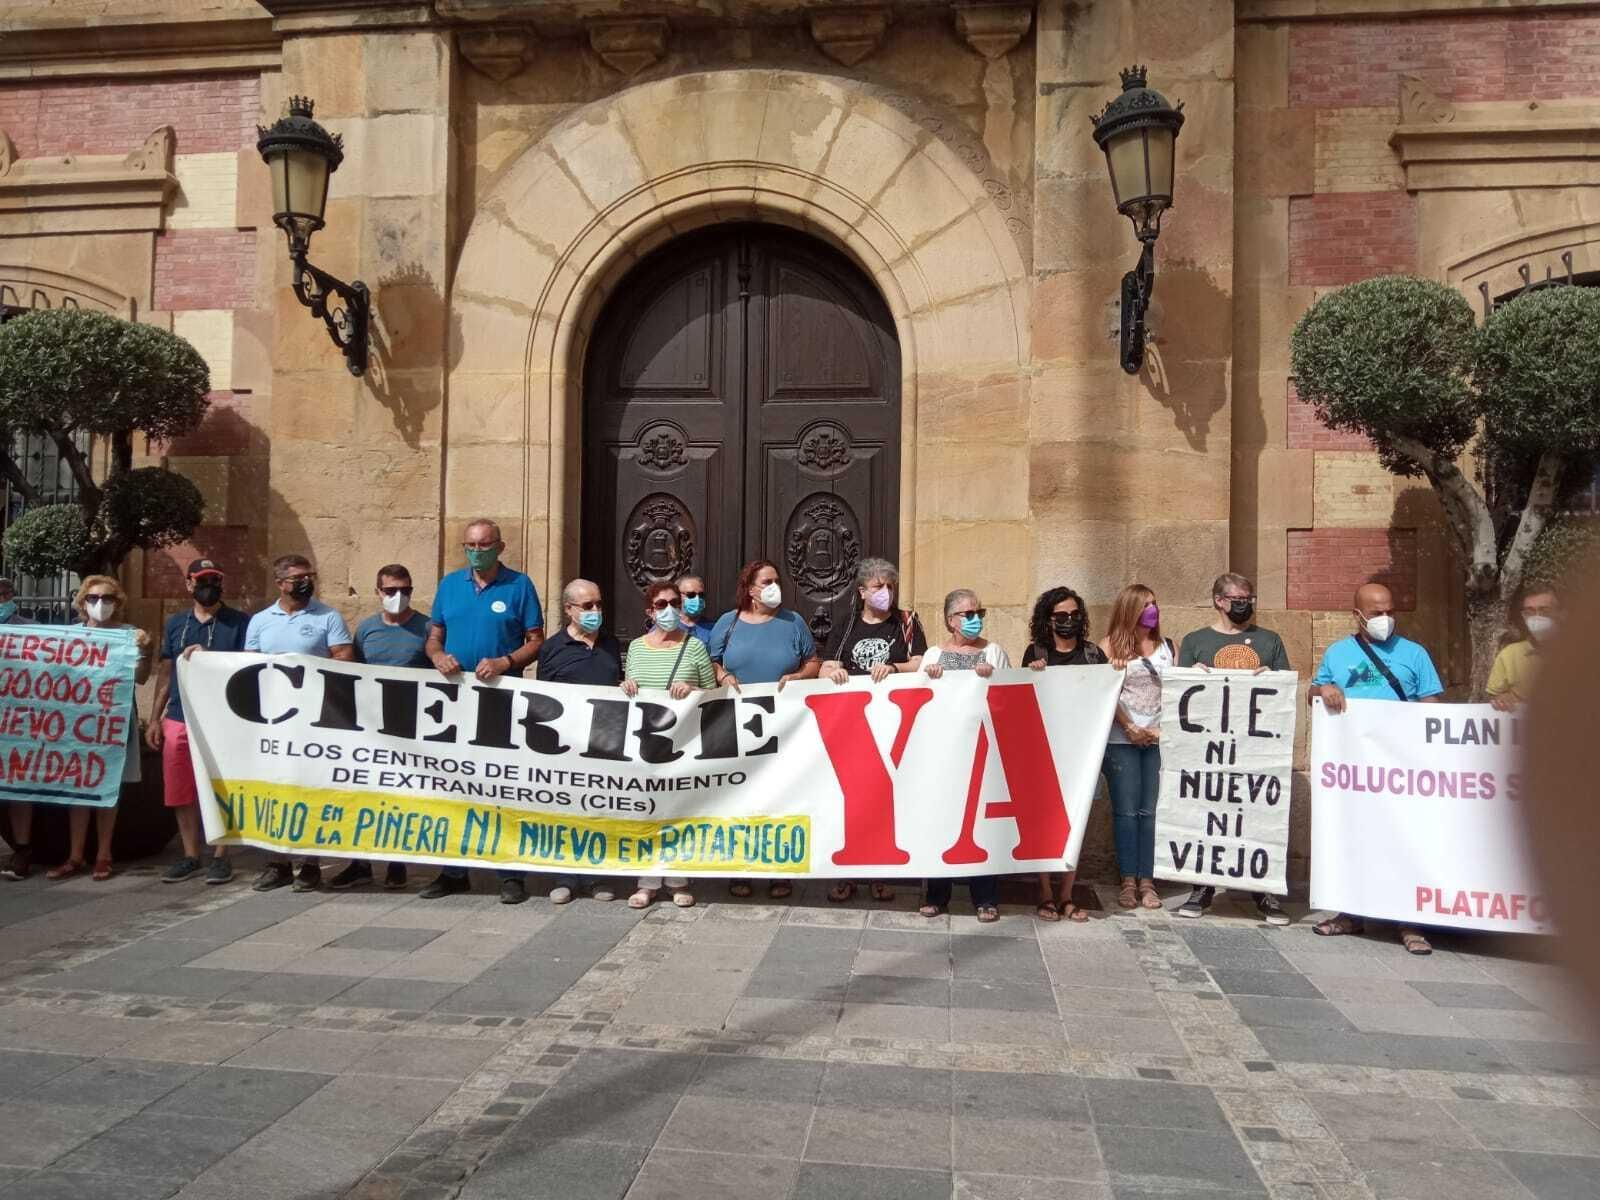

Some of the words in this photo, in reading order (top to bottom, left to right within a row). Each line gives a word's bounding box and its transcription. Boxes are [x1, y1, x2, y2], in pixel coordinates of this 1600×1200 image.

[73, 713, 126, 747] CIE
[226, 662, 778, 763] CIERRE
[1425, 717, 1500, 746] PLAN
[260, 738, 279, 755] DE
[286, 741, 342, 760] LOS
[352, 747, 476, 776] CENTROS
[485, 763, 519, 780] DE
[528, 767, 747, 793] INTERNAMIENTO
[1206, 738, 1237, 766] NI
[332, 767, 370, 785] DE
[378, 771, 571, 806] EXTRANJEROS
[581, 793, 656, 815] (CIEs)
[805, 683, 1072, 866] YA
[1179, 768, 1281, 806] NUEVO
[1321, 762, 1497, 800] SOLUCIONES
[254, 792, 308, 842] VIEJO
[315, 826, 342, 845] LA
[352, 801, 449, 853] PIÑERA
[460, 806, 501, 856] NI
[518, 819, 607, 865] NUEVO
[618, 837, 653, 864] EN
[659, 823, 806, 864] BOTAFUEGO
[1206, 808, 1244, 838] NI
[1169, 839, 1269, 879] VIEJO
